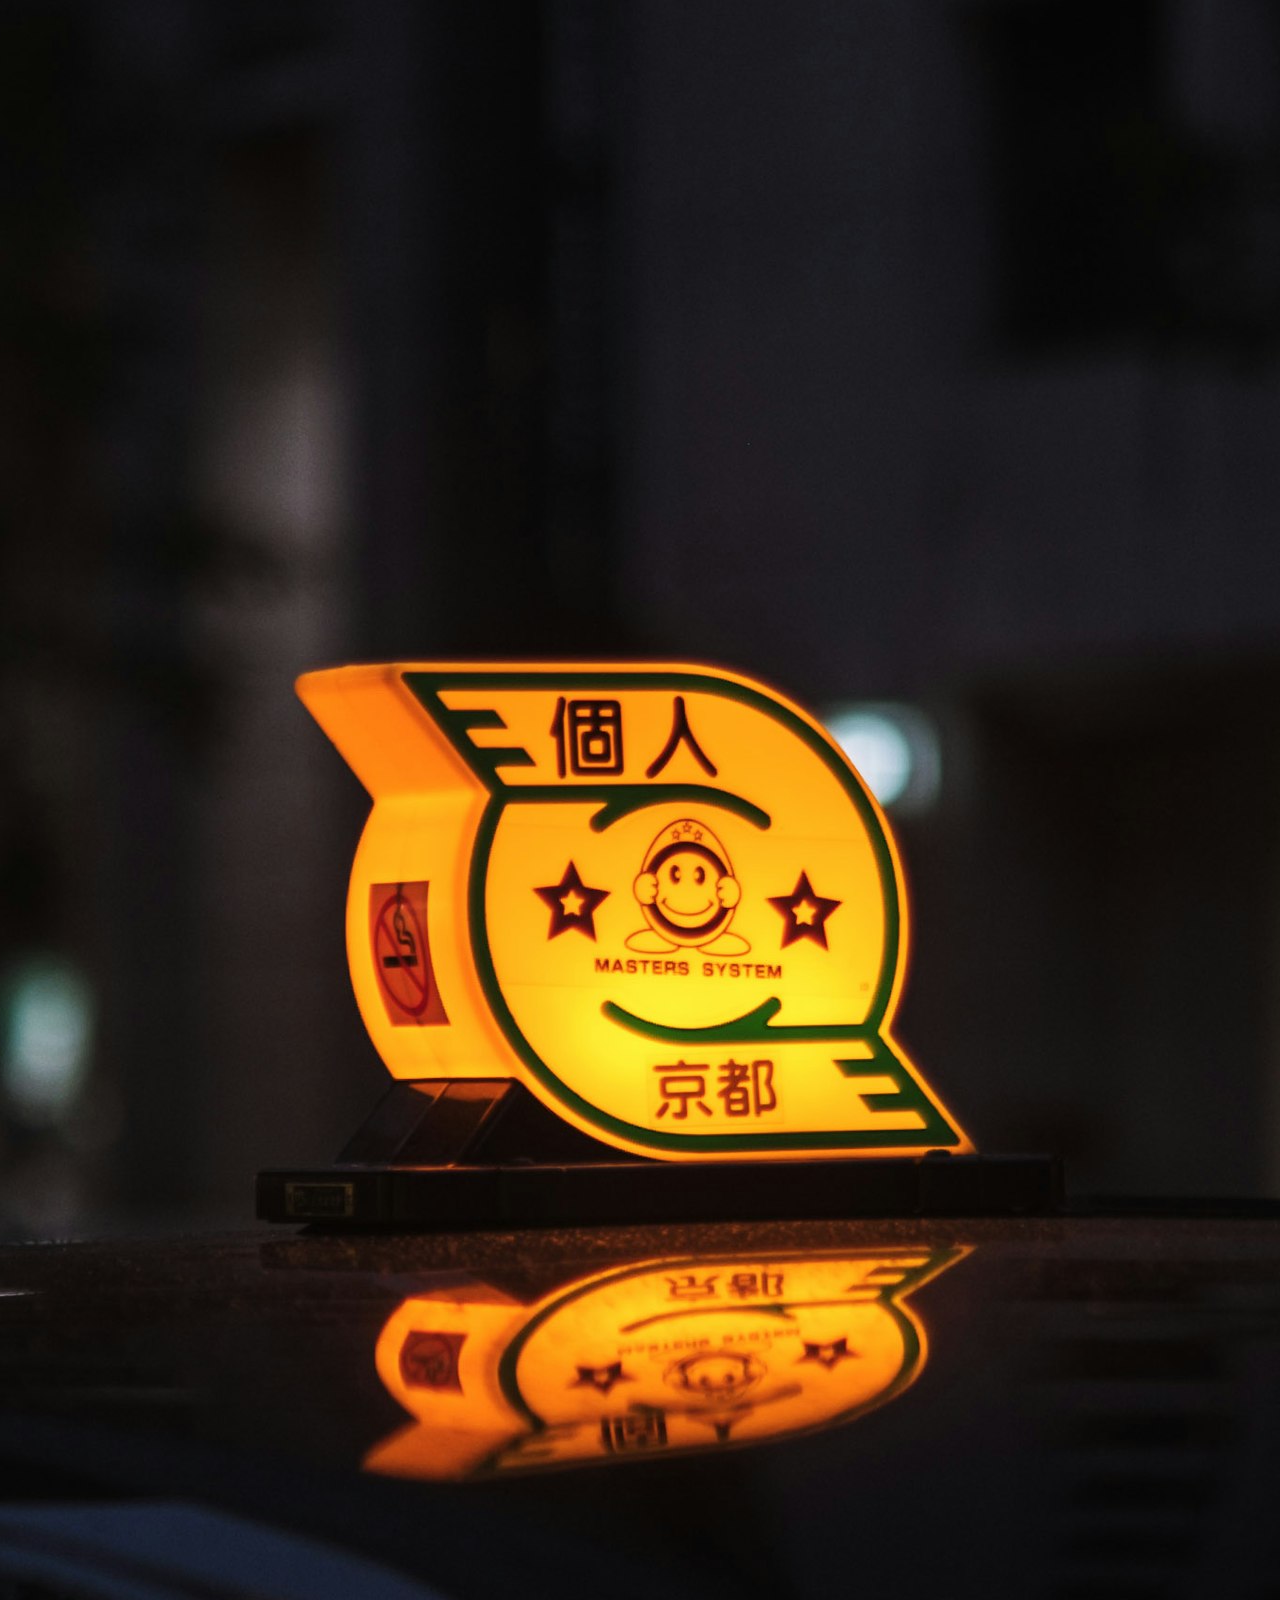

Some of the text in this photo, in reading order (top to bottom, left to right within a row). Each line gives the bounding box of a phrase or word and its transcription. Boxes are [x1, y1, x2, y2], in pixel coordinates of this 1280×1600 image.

[550, 696, 718, 779] 個人
[594, 958, 783, 979] MASTERS SYSTEM
[652, 1059, 777, 1119] 京都
